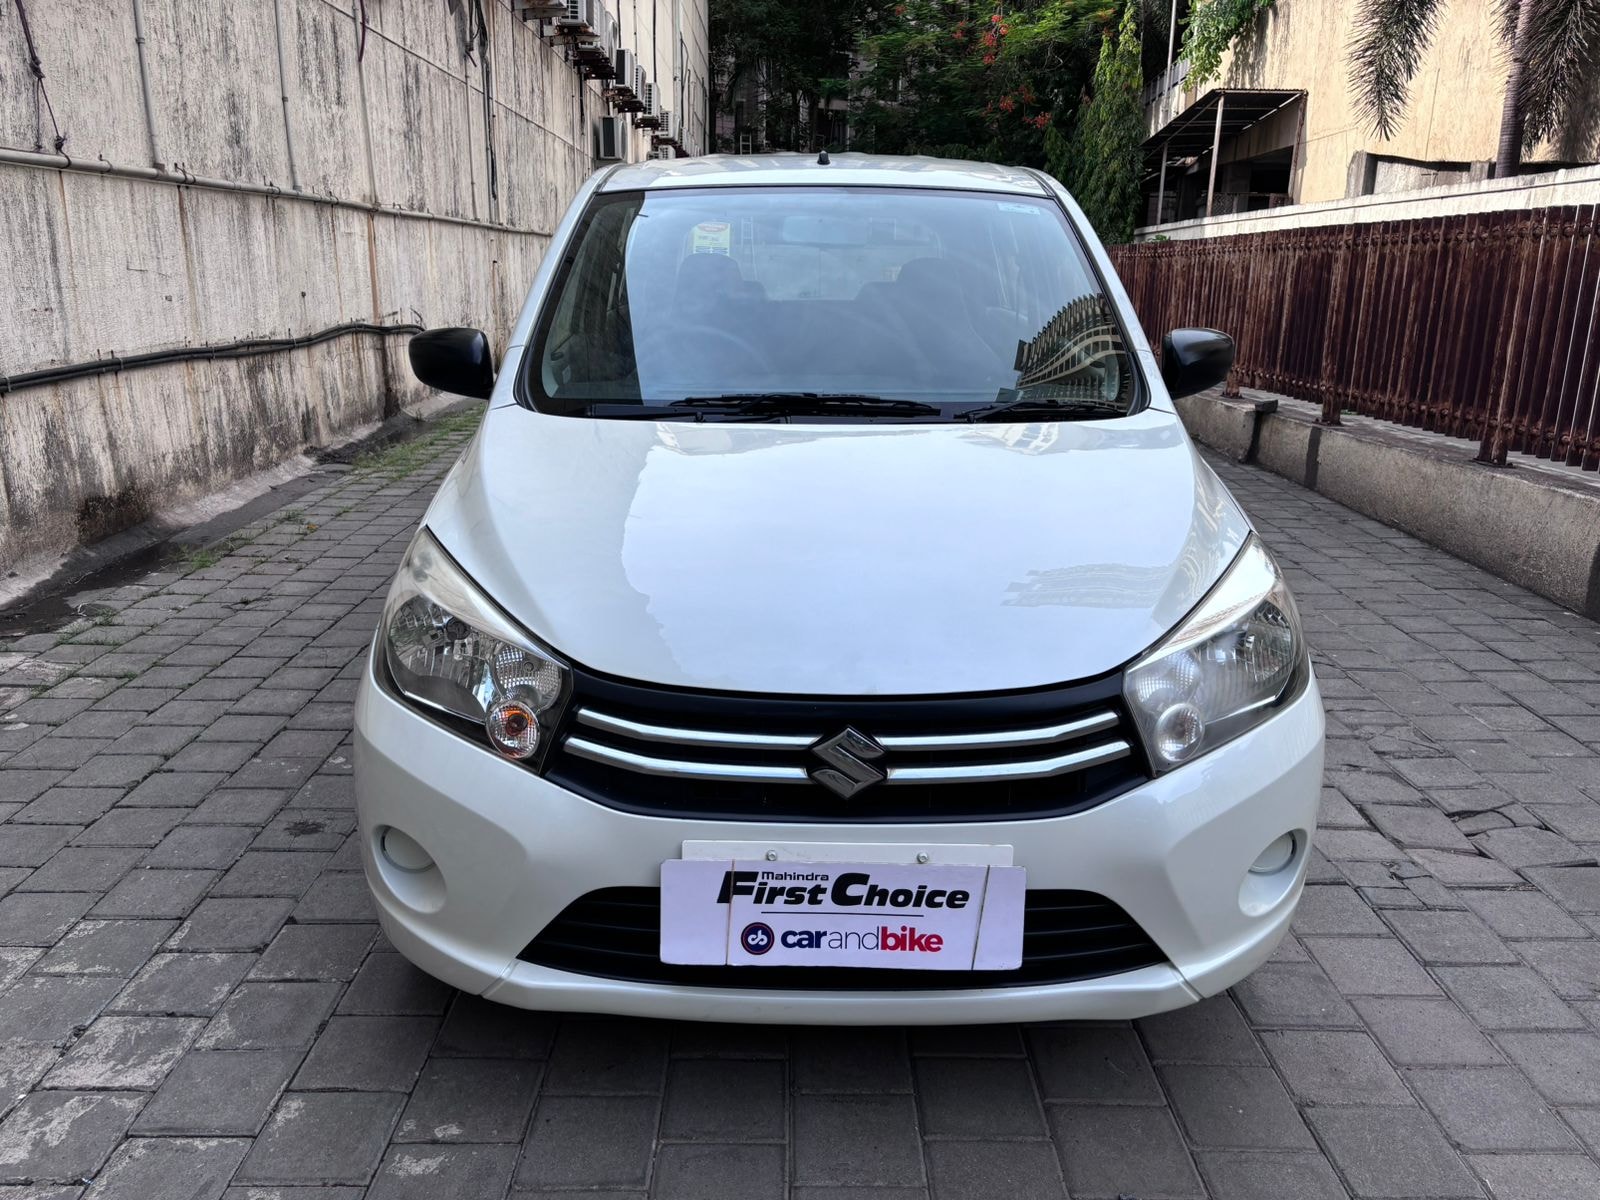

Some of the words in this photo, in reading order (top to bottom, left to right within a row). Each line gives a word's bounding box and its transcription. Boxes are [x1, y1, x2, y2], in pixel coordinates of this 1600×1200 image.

[717, 871, 828, 905] First
[831, 873, 970, 908] Choice
[761, 871, 829, 882] Mahindra
[780, 926, 943, 952] carandbike
